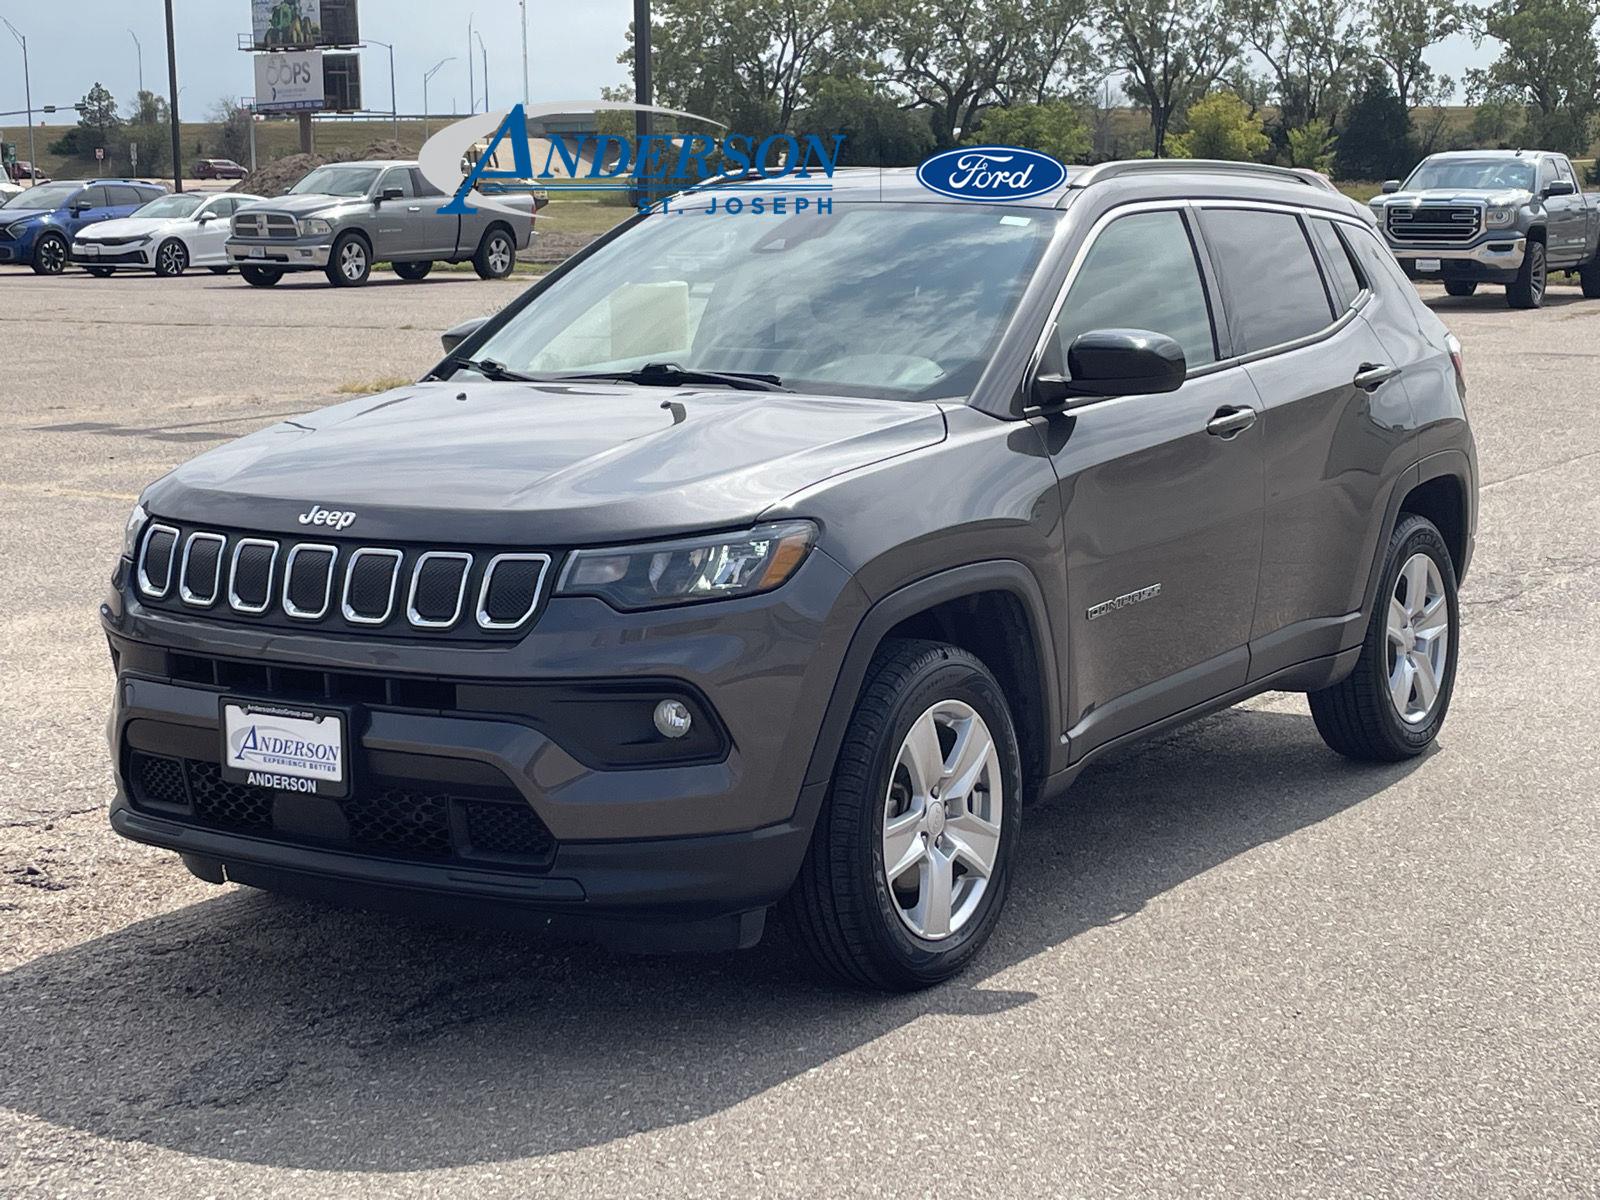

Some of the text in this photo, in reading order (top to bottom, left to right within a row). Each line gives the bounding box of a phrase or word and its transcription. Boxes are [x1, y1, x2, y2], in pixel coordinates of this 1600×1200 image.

[298, 505, 357, 531] Jeep
[1087, 583, 1162, 621] COMPASS
[234, 725, 340, 762] ANDERSON
[263, 756, 337, 773] EXPERIENCE BETTER
[247, 771, 317, 794] ANDERSON
